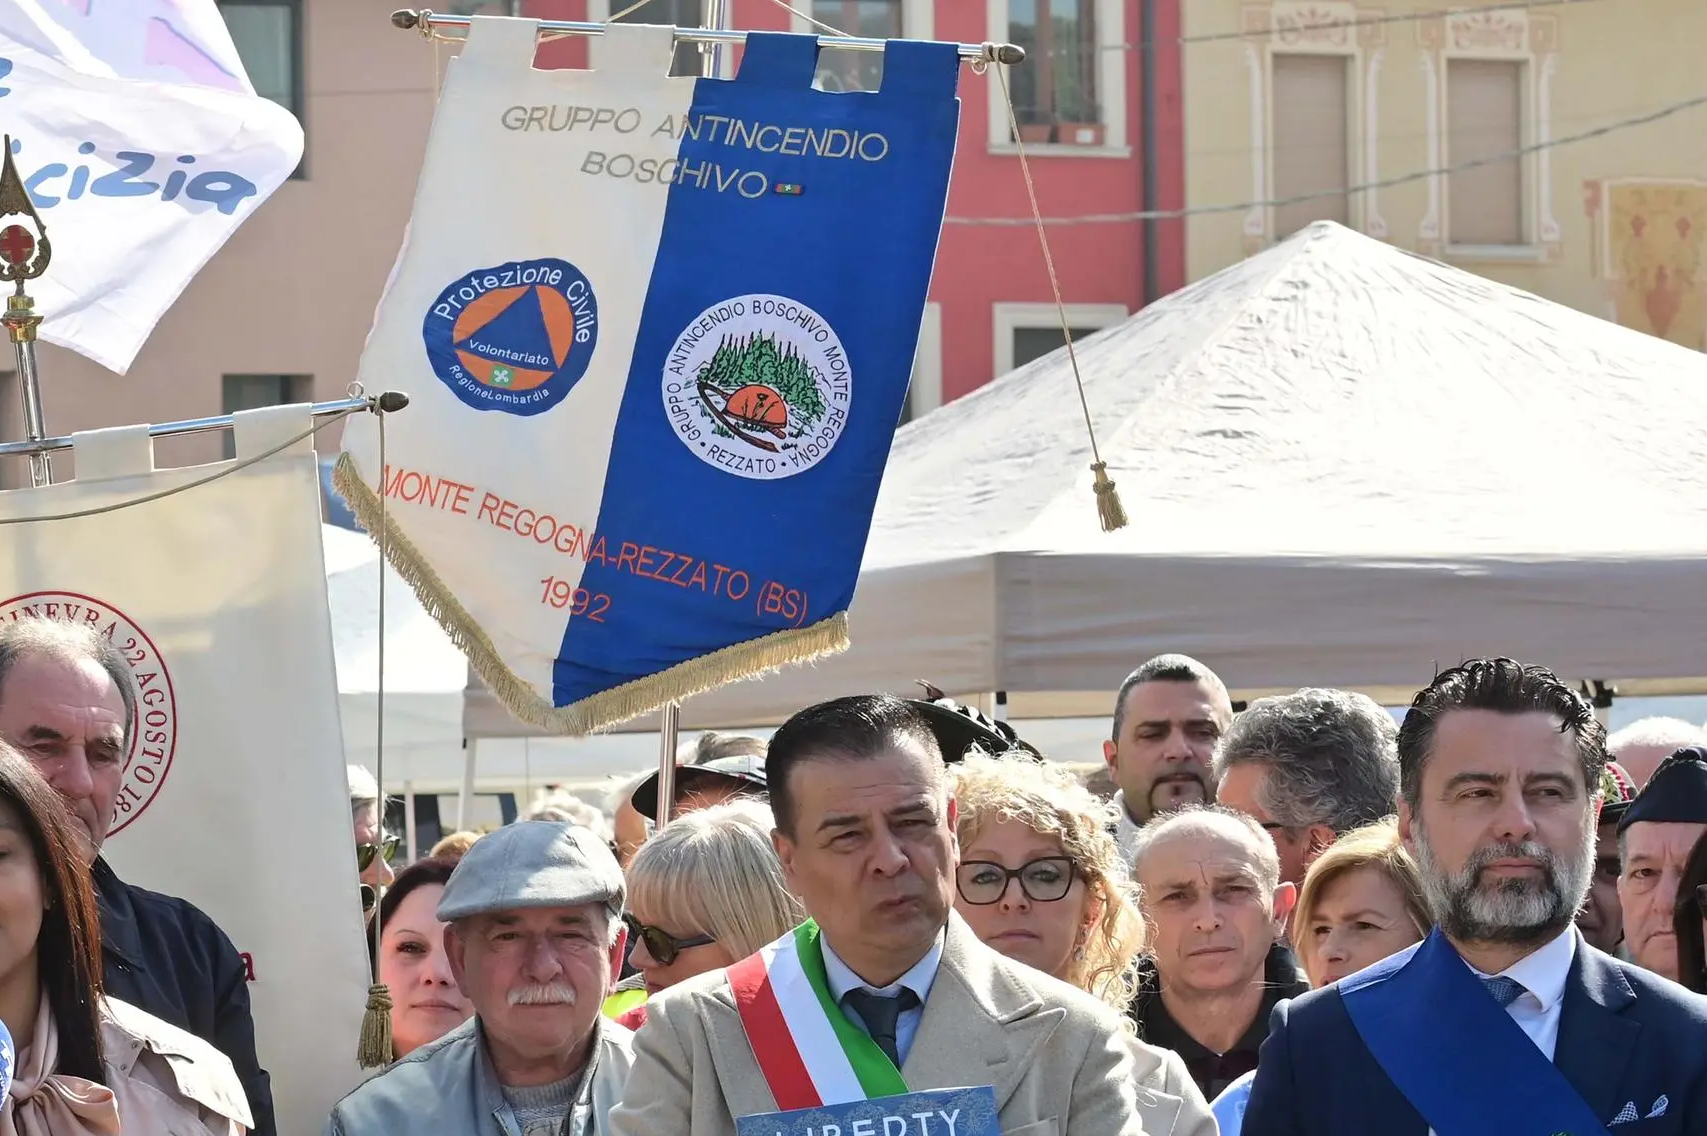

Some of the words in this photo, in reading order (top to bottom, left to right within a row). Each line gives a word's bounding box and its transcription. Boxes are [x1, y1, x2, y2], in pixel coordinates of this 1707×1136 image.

[500, 105, 642, 134] GRUPPO
[650, 114, 889, 162] ANTINCENDIO
[580, 150, 768, 199] BOSCHIVO
[433, 265, 562, 321] Protezione
[566, 280, 595, 343] Civile
[752, 300, 829, 343] BOSCHIVO
[469, 339, 549, 366] Volontariato
[669, 302, 745, 376] ANTINCENDIO
[823, 345, 848, 402] MONTE
[666, 382, 701, 441] GRUPPO
[789, 406, 845, 468] REGOGNA
[706, 445, 776, 474] REZZATO
[376, 464, 475, 515] MONTE
[477, 490, 750, 601] REGOGNA-REZZATO
[756, 581, 809, 627] (BS)
[539, 575, 612, 623] 1992
[118, 637, 146, 667] 22
[134, 672, 168, 784] AGOSTO
